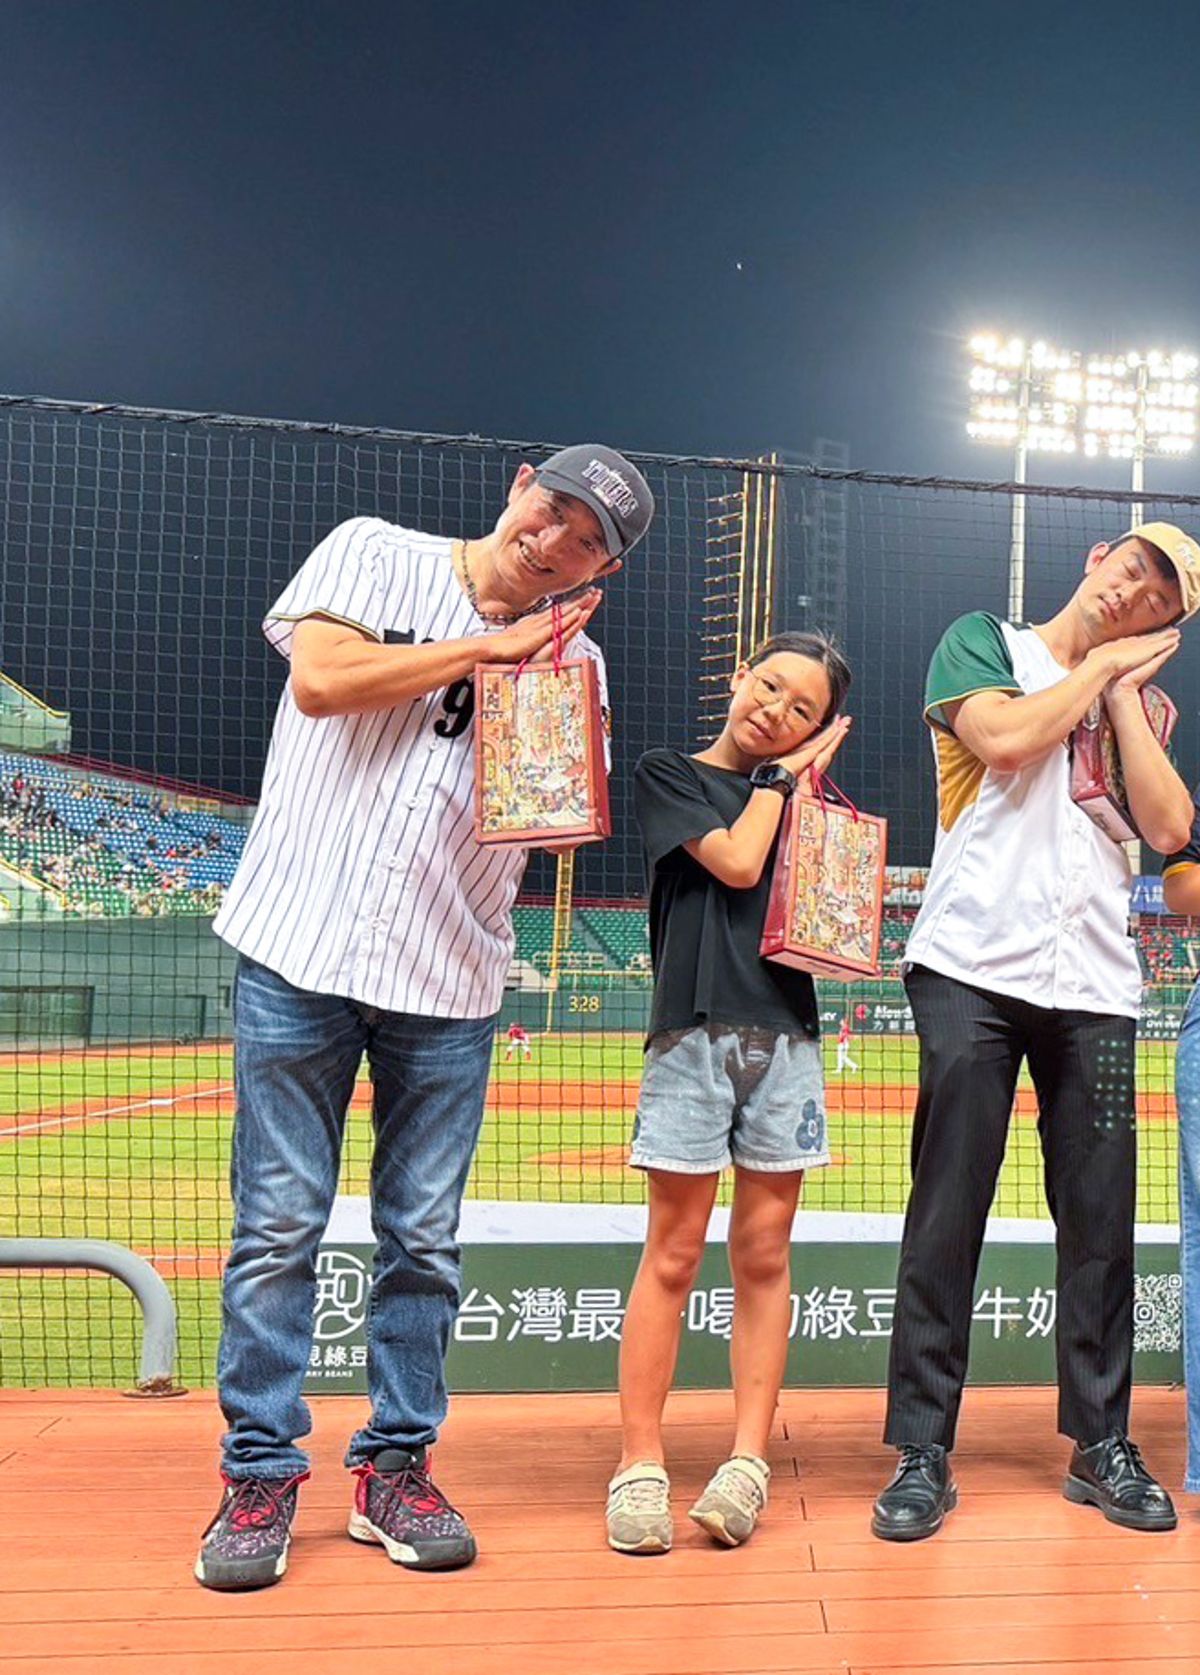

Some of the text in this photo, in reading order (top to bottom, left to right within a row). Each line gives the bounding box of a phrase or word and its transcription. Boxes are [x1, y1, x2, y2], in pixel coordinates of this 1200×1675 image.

[568, 995, 599, 1012] 328
[454, 1286, 1058, 1342] 台灣最喝綠豆牛奶
[325, 1370, 353, 1378] BEANS
